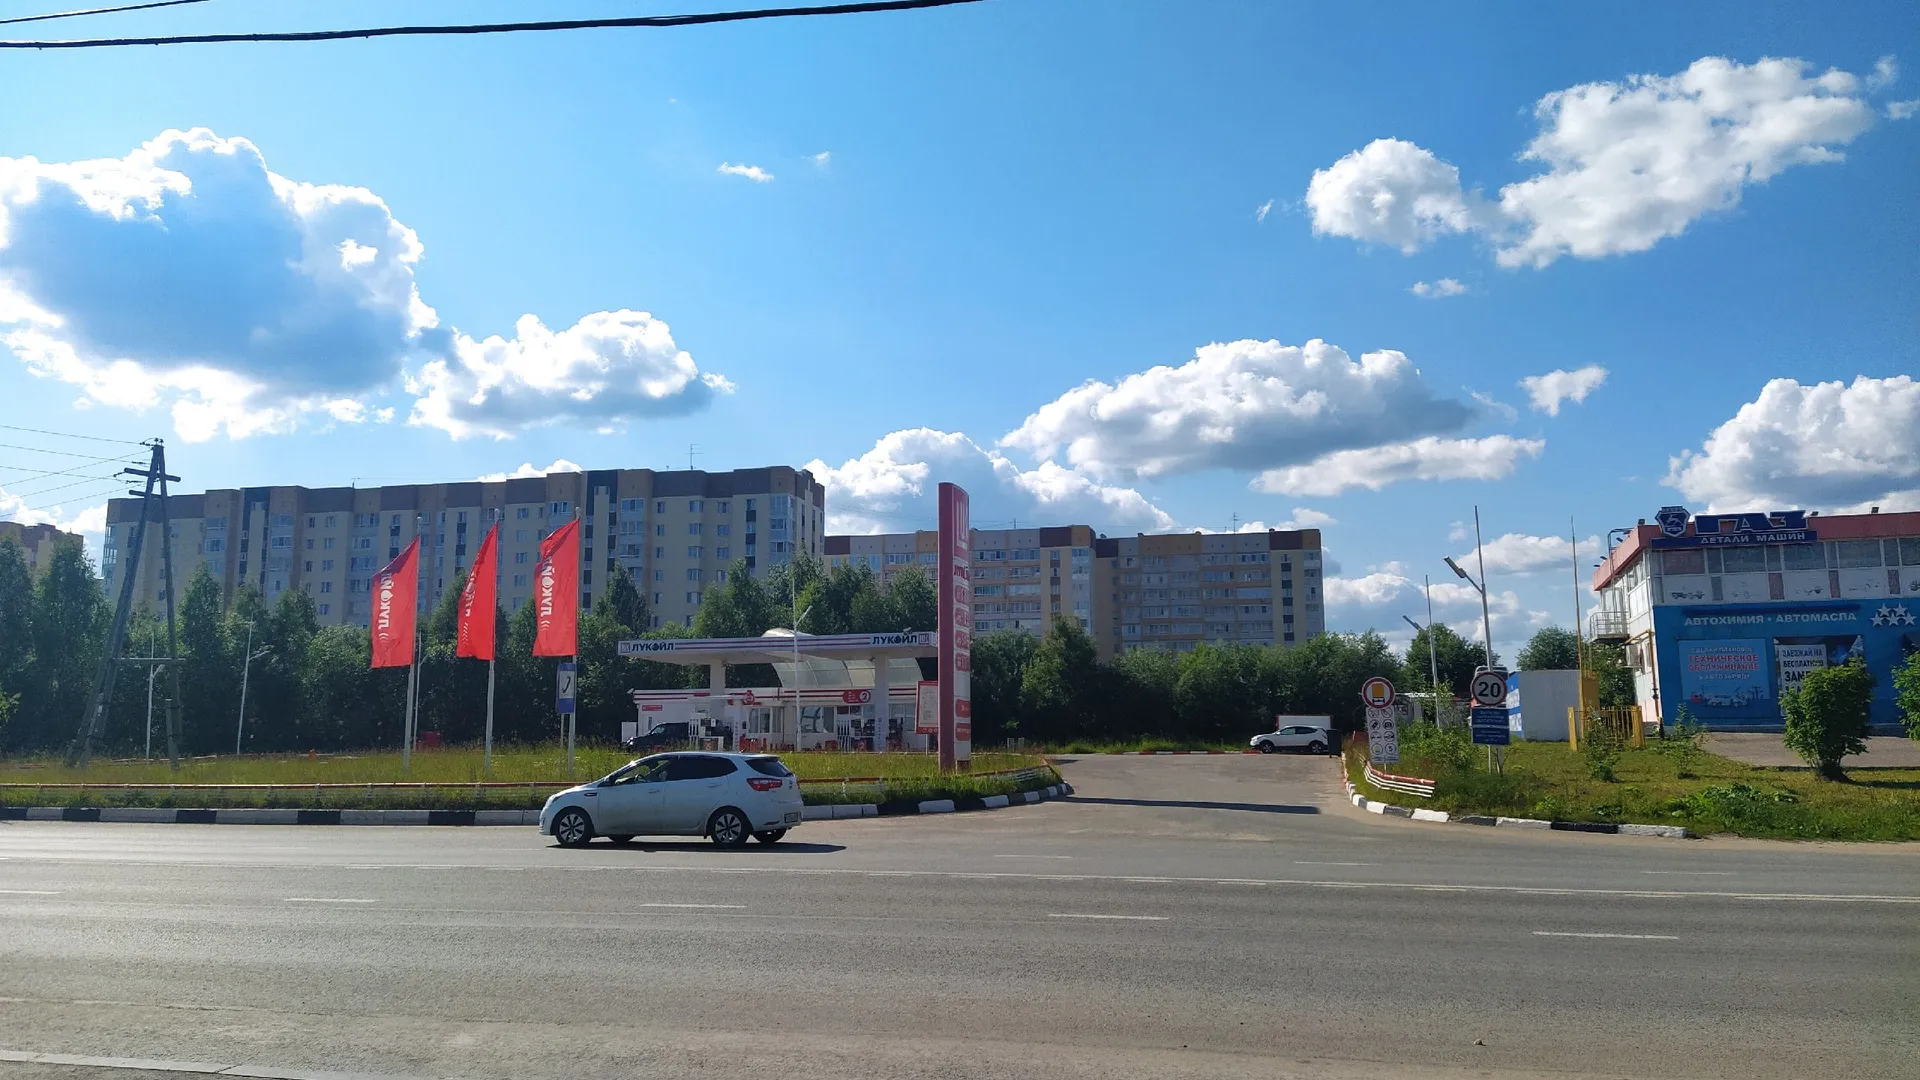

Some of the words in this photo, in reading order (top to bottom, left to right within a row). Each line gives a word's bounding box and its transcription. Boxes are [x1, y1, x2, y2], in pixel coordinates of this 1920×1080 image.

[1695, 510, 1807, 534] ГАЗ
[1700, 535, 1749, 544] ДЕТАЛИ
[1756, 532, 1806, 542] МАШИН
[1684, 615, 1764, 626] АВТОХИМИЯ
[1775, 612, 1857, 623] АВТОМАСЛА
[872, 634, 917, 645] ЛУКОЙЛ
[632, 641, 674, 651] ЛУКОЙЛ
[1782, 648, 1813, 657] ЗАЕЗЖАЙ
[1813, 648, 1822, 656] НА
[1688, 654, 1759, 663] ТЕХНИЧЕСКОЕ
[1688, 663, 1759, 671] ОБСЛУЖИВАНИЕ
[1478, 682, 1501, 698] 20
[862, 692, 868, 700] 2
